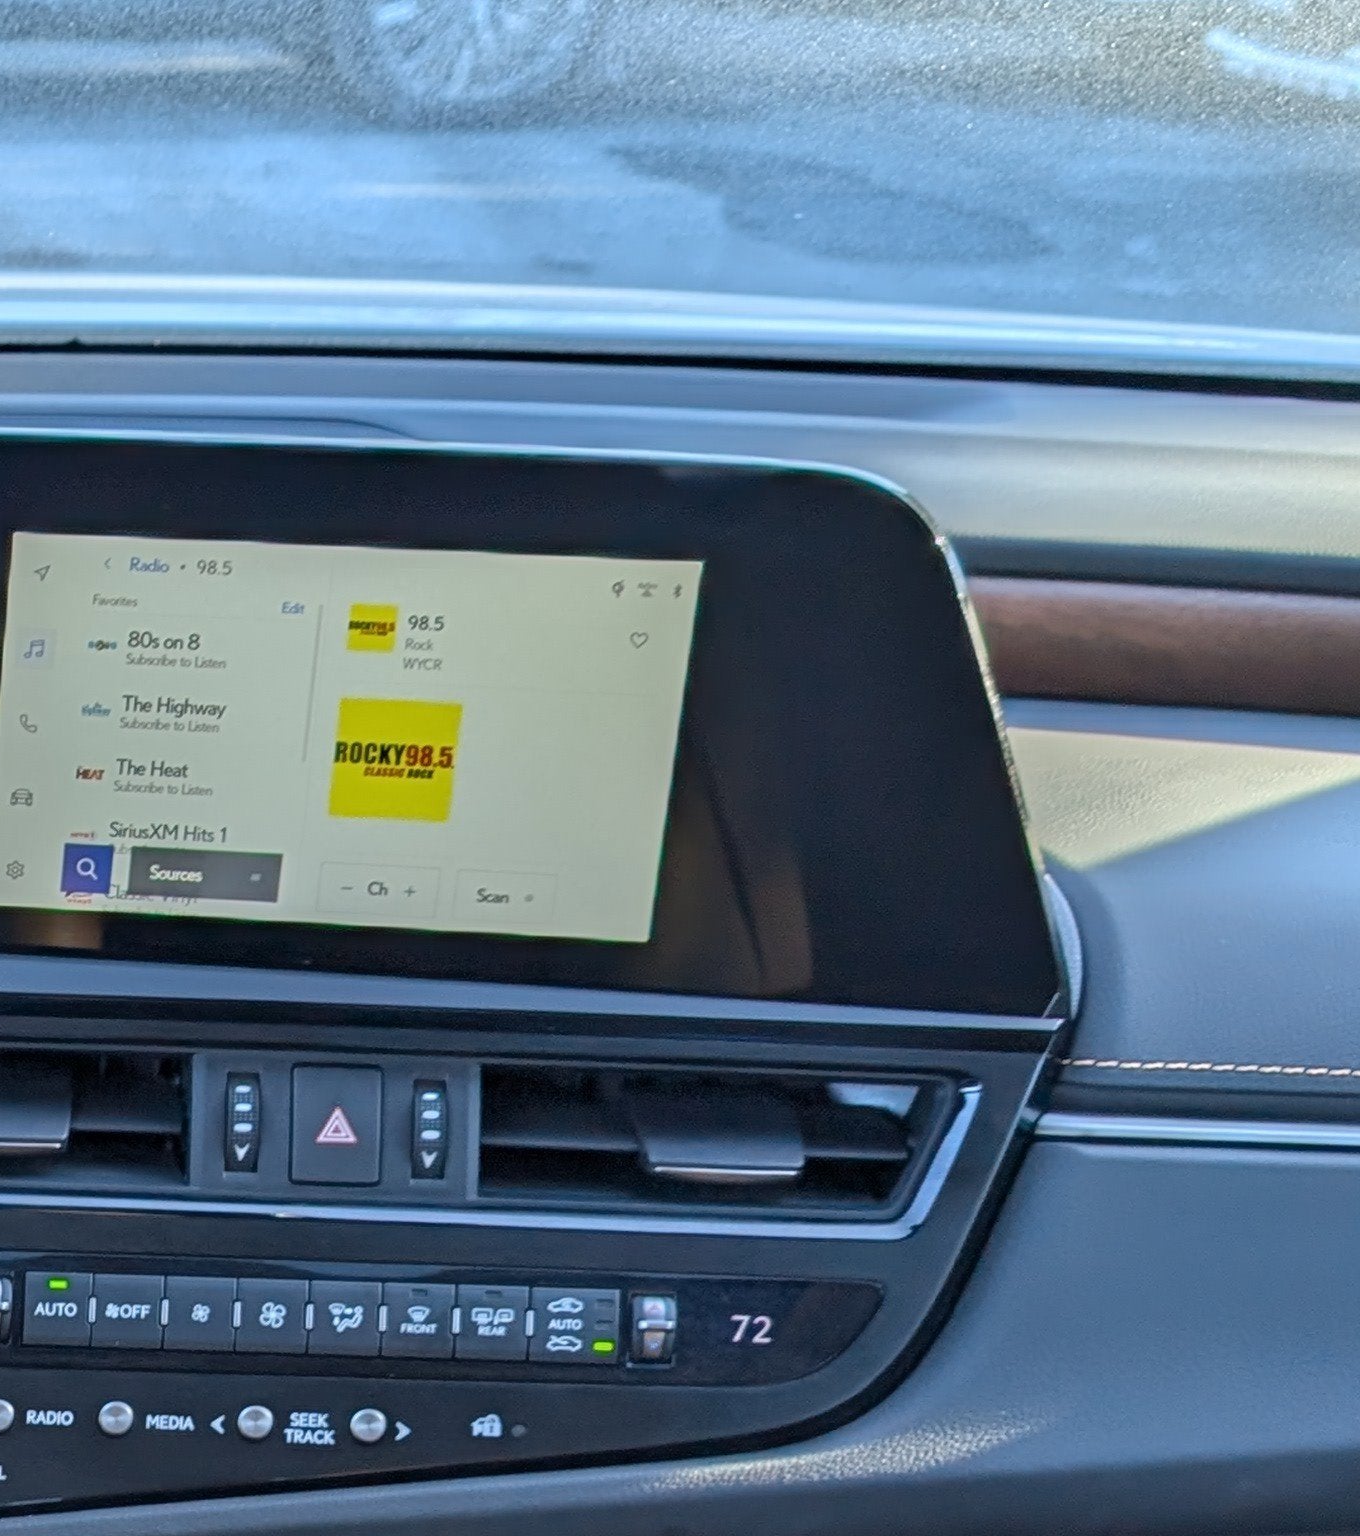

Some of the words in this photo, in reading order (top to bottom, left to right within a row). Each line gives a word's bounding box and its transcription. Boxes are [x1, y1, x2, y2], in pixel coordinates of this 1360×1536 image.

[129, 556, 170, 574] Radio
[196, 559, 233, 576] 98.5
[91, 592, 138, 608] Favorites
[280, 601, 306, 615] Edit
[407, 614, 445, 632] 98.5
[127, 630, 160, 650] 80s
[163, 637, 184, 651] on
[187, 633, 201, 651] 8
[404, 637, 434, 651] Rock
[125, 652, 177, 668] Subscribe
[180, 656, 192, 668] to
[194, 656, 227, 670] Listen
[402, 657, 443, 671] WYCR
[122, 694, 153, 714] The
[156, 696, 227, 720] Highway
[119, 716, 170, 731] Subscribe
[173, 720, 186, 732] to
[188, 720, 220, 734] Listen
[116, 757, 146, 777] The
[150, 760, 190, 779] Heat
[363, 765, 406, 778] CLASSIC
[406, 769, 435, 780] ROCK
[112, 779, 164, 795] Subscribe
[167, 783, 179, 795] to
[181, 783, 214, 797] Listen
[109, 820, 179, 841] SiriusXM
[182, 825, 215, 843] Hits
[219, 826, 228, 843] 1
[148, 863, 204, 883] Sources
[366, 880, 389, 897] Ch
[476, 887, 510, 904] Scan
[33, 1301, 78, 1318] AUTO
[119, 1303, 152, 1320] OFF
[399, 1322, 438, 1335] FRONT
[477, 1325, 507, 1337] REAR
[547, 1318, 584, 1331] AUTO
[728, 1313, 775, 1345] 72
[25, 1409, 75, 1427] RADIO
[145, 1413, 196, 1432] MEDIA
[289, 1412, 329, 1429] SEEK
[283, 1428, 336, 1446] TRACK
